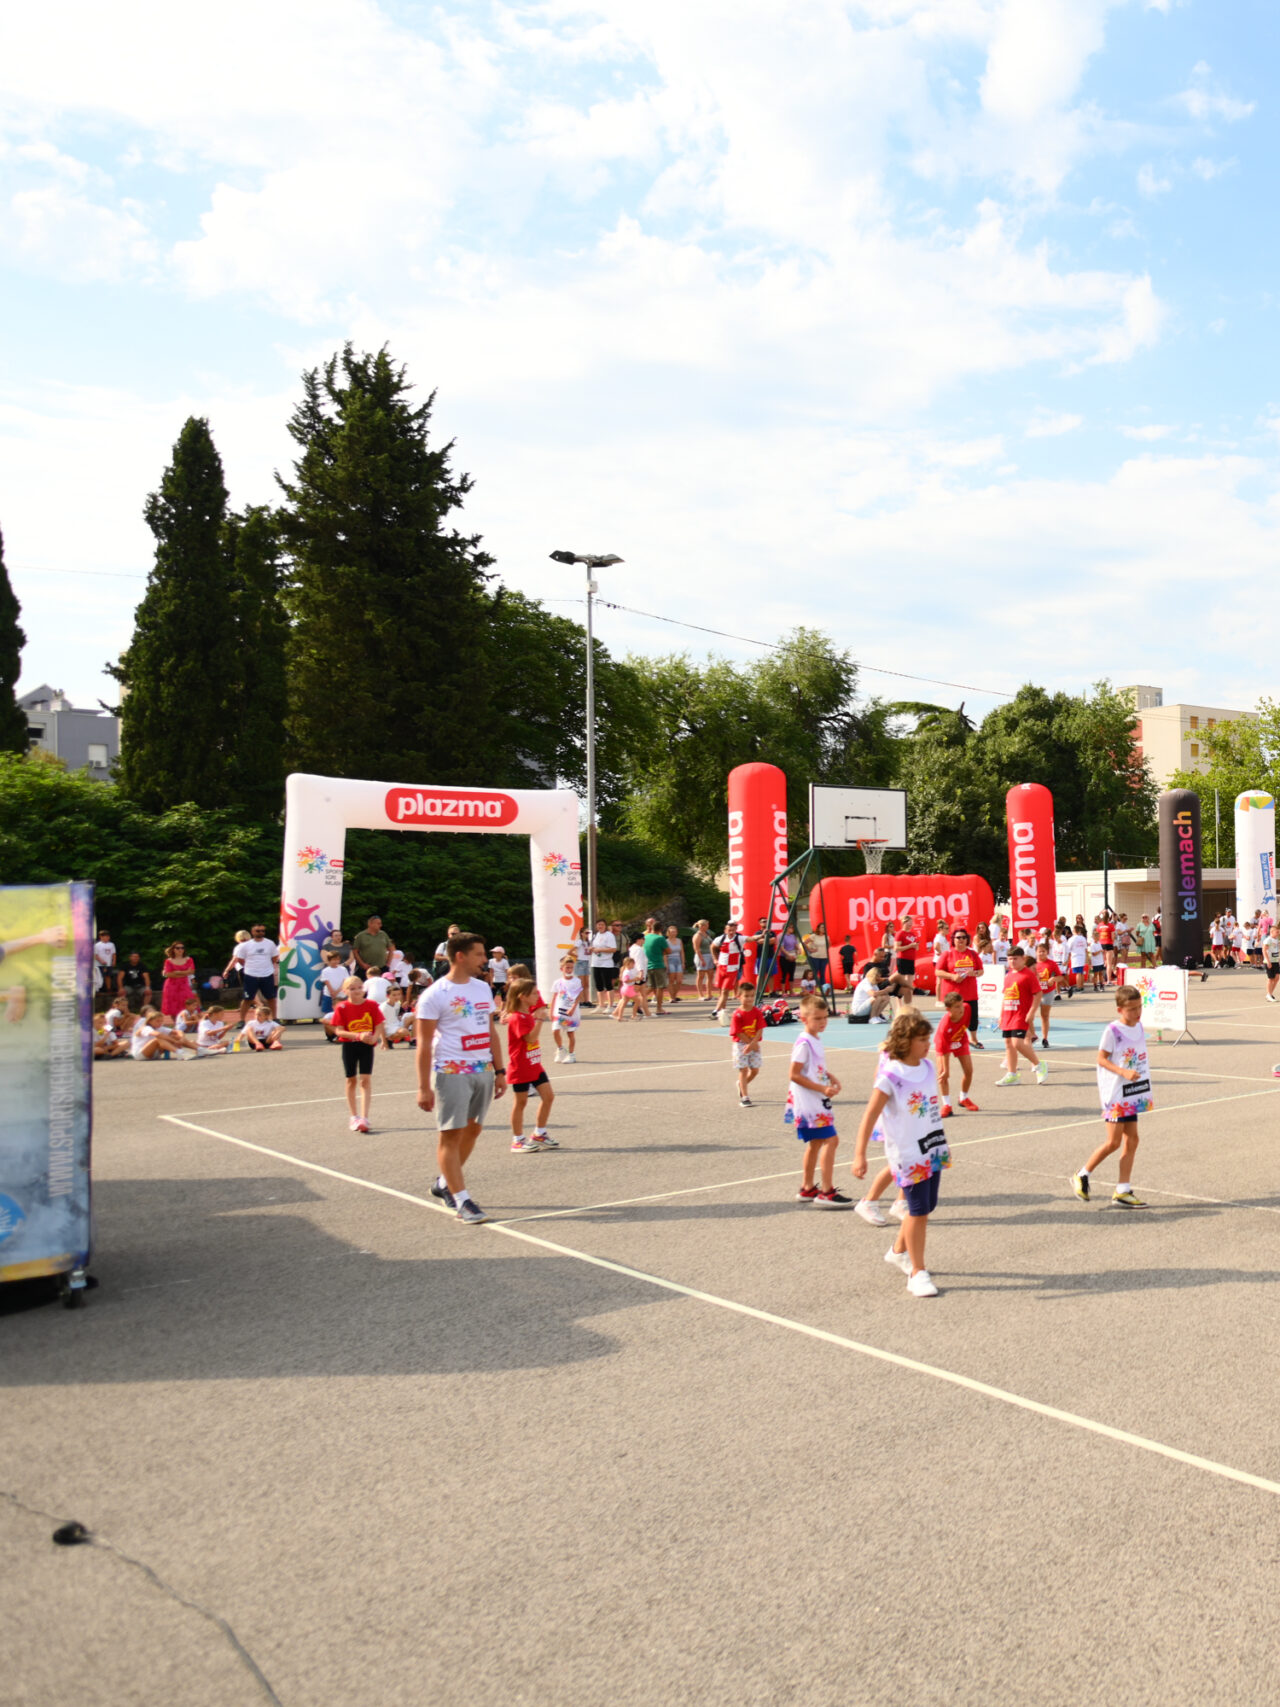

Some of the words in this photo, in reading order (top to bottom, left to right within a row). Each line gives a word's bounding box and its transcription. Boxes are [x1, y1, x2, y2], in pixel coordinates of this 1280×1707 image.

[397, 793, 502, 820] plazma
[770, 811, 788, 931] lazma
[849, 889, 970, 931] plazma
[1013, 822, 1040, 929] lazma
[1173, 811, 1198, 921] telemach
